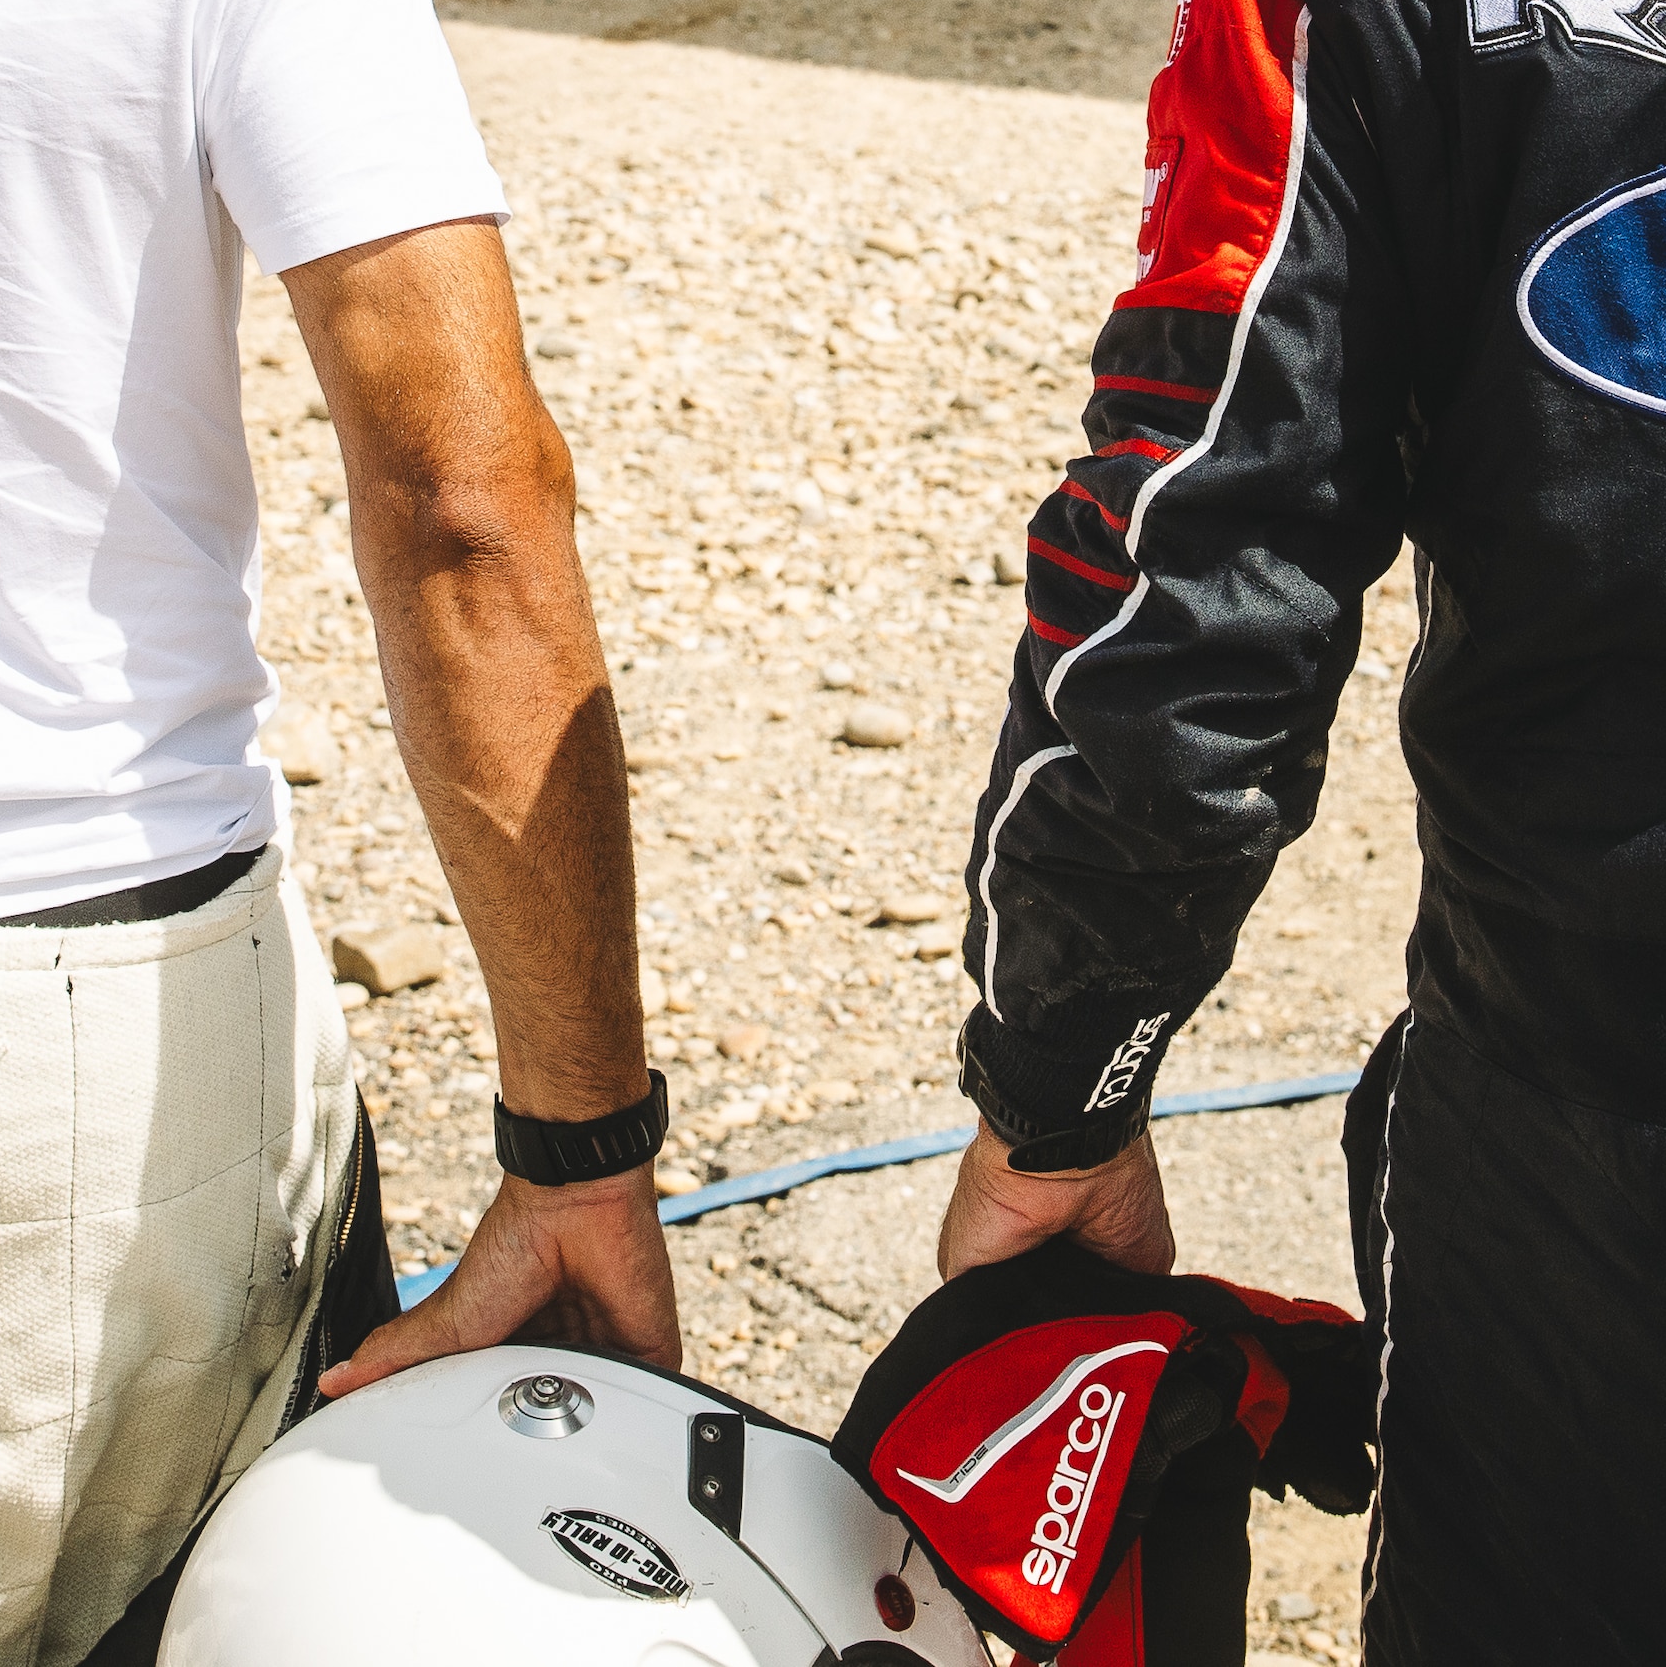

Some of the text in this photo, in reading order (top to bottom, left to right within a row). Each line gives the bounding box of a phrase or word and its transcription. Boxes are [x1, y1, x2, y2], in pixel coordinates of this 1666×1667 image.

[1085, 1012, 1171, 1112] sparco
[950, 1444, 989, 1485] TIDE
[1022, 1384, 1121, 1593] sparco
[541, 1511, 690, 1598] MAG-10 RALLY
[594, 1514, 657, 1551] SERIES
[589, 1561, 629, 1588] PRO
